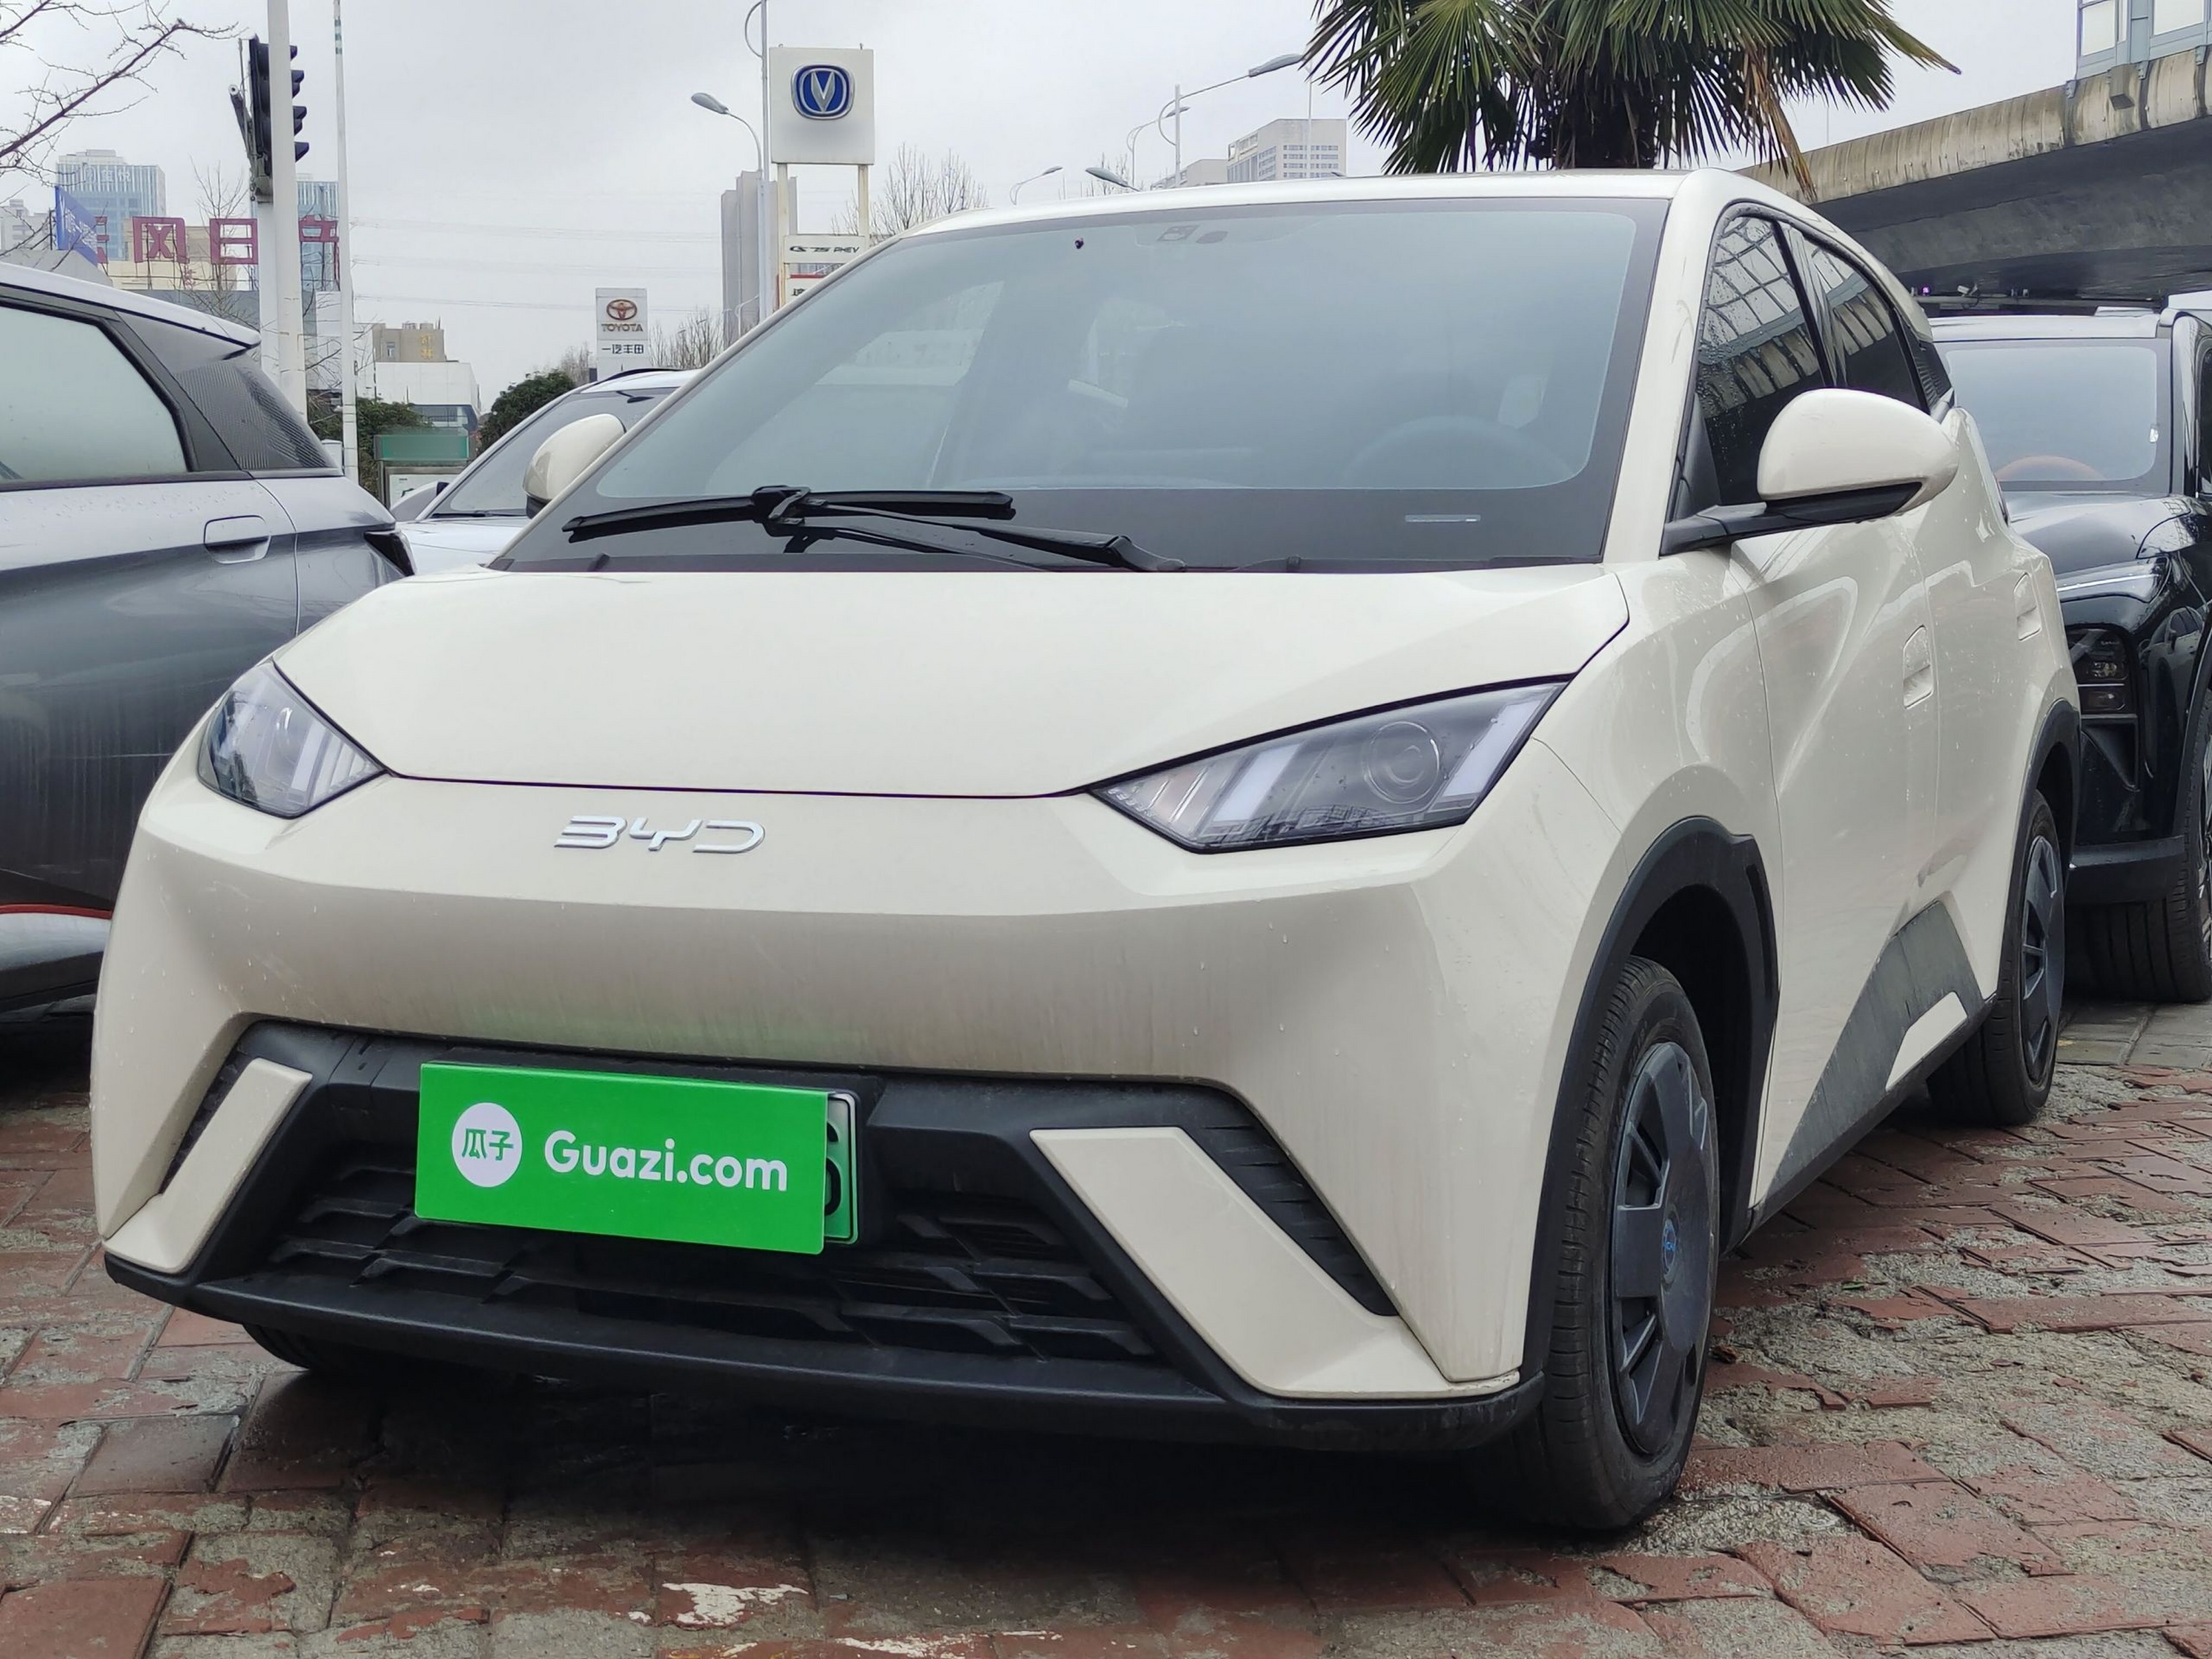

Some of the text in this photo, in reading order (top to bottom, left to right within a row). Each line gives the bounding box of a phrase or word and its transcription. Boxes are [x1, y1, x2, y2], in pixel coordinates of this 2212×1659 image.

[601, 323, 643, 332] TOYOTA
[601, 344, 644, 354] 一汽丰田
[554, 816, 765, 854] BYD
[461, 1128, 514, 1161] 瓜子
[544, 1130, 788, 1191] Guazi.com
